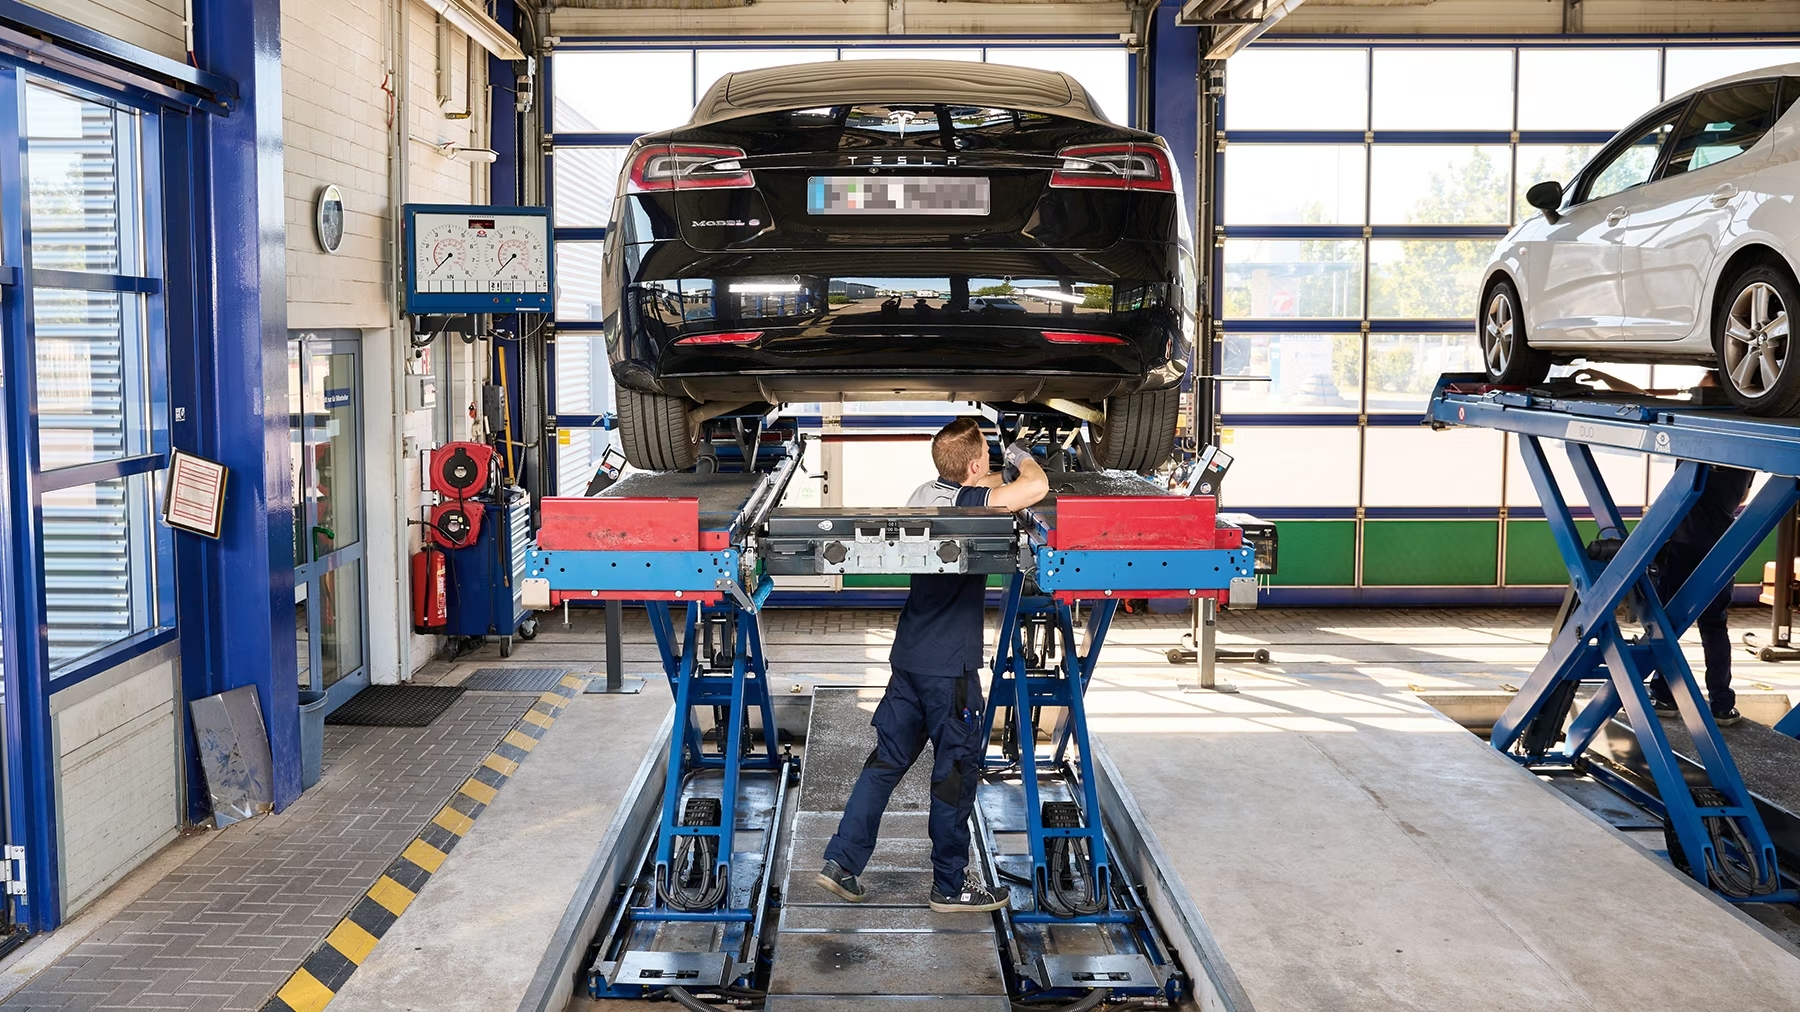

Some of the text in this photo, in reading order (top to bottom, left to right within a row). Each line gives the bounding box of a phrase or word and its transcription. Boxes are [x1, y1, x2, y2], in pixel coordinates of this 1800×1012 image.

[847, 156, 957, 165] TESLA
[691, 219, 745, 227] MODEL
[1580, 426, 1594, 438] DUO
